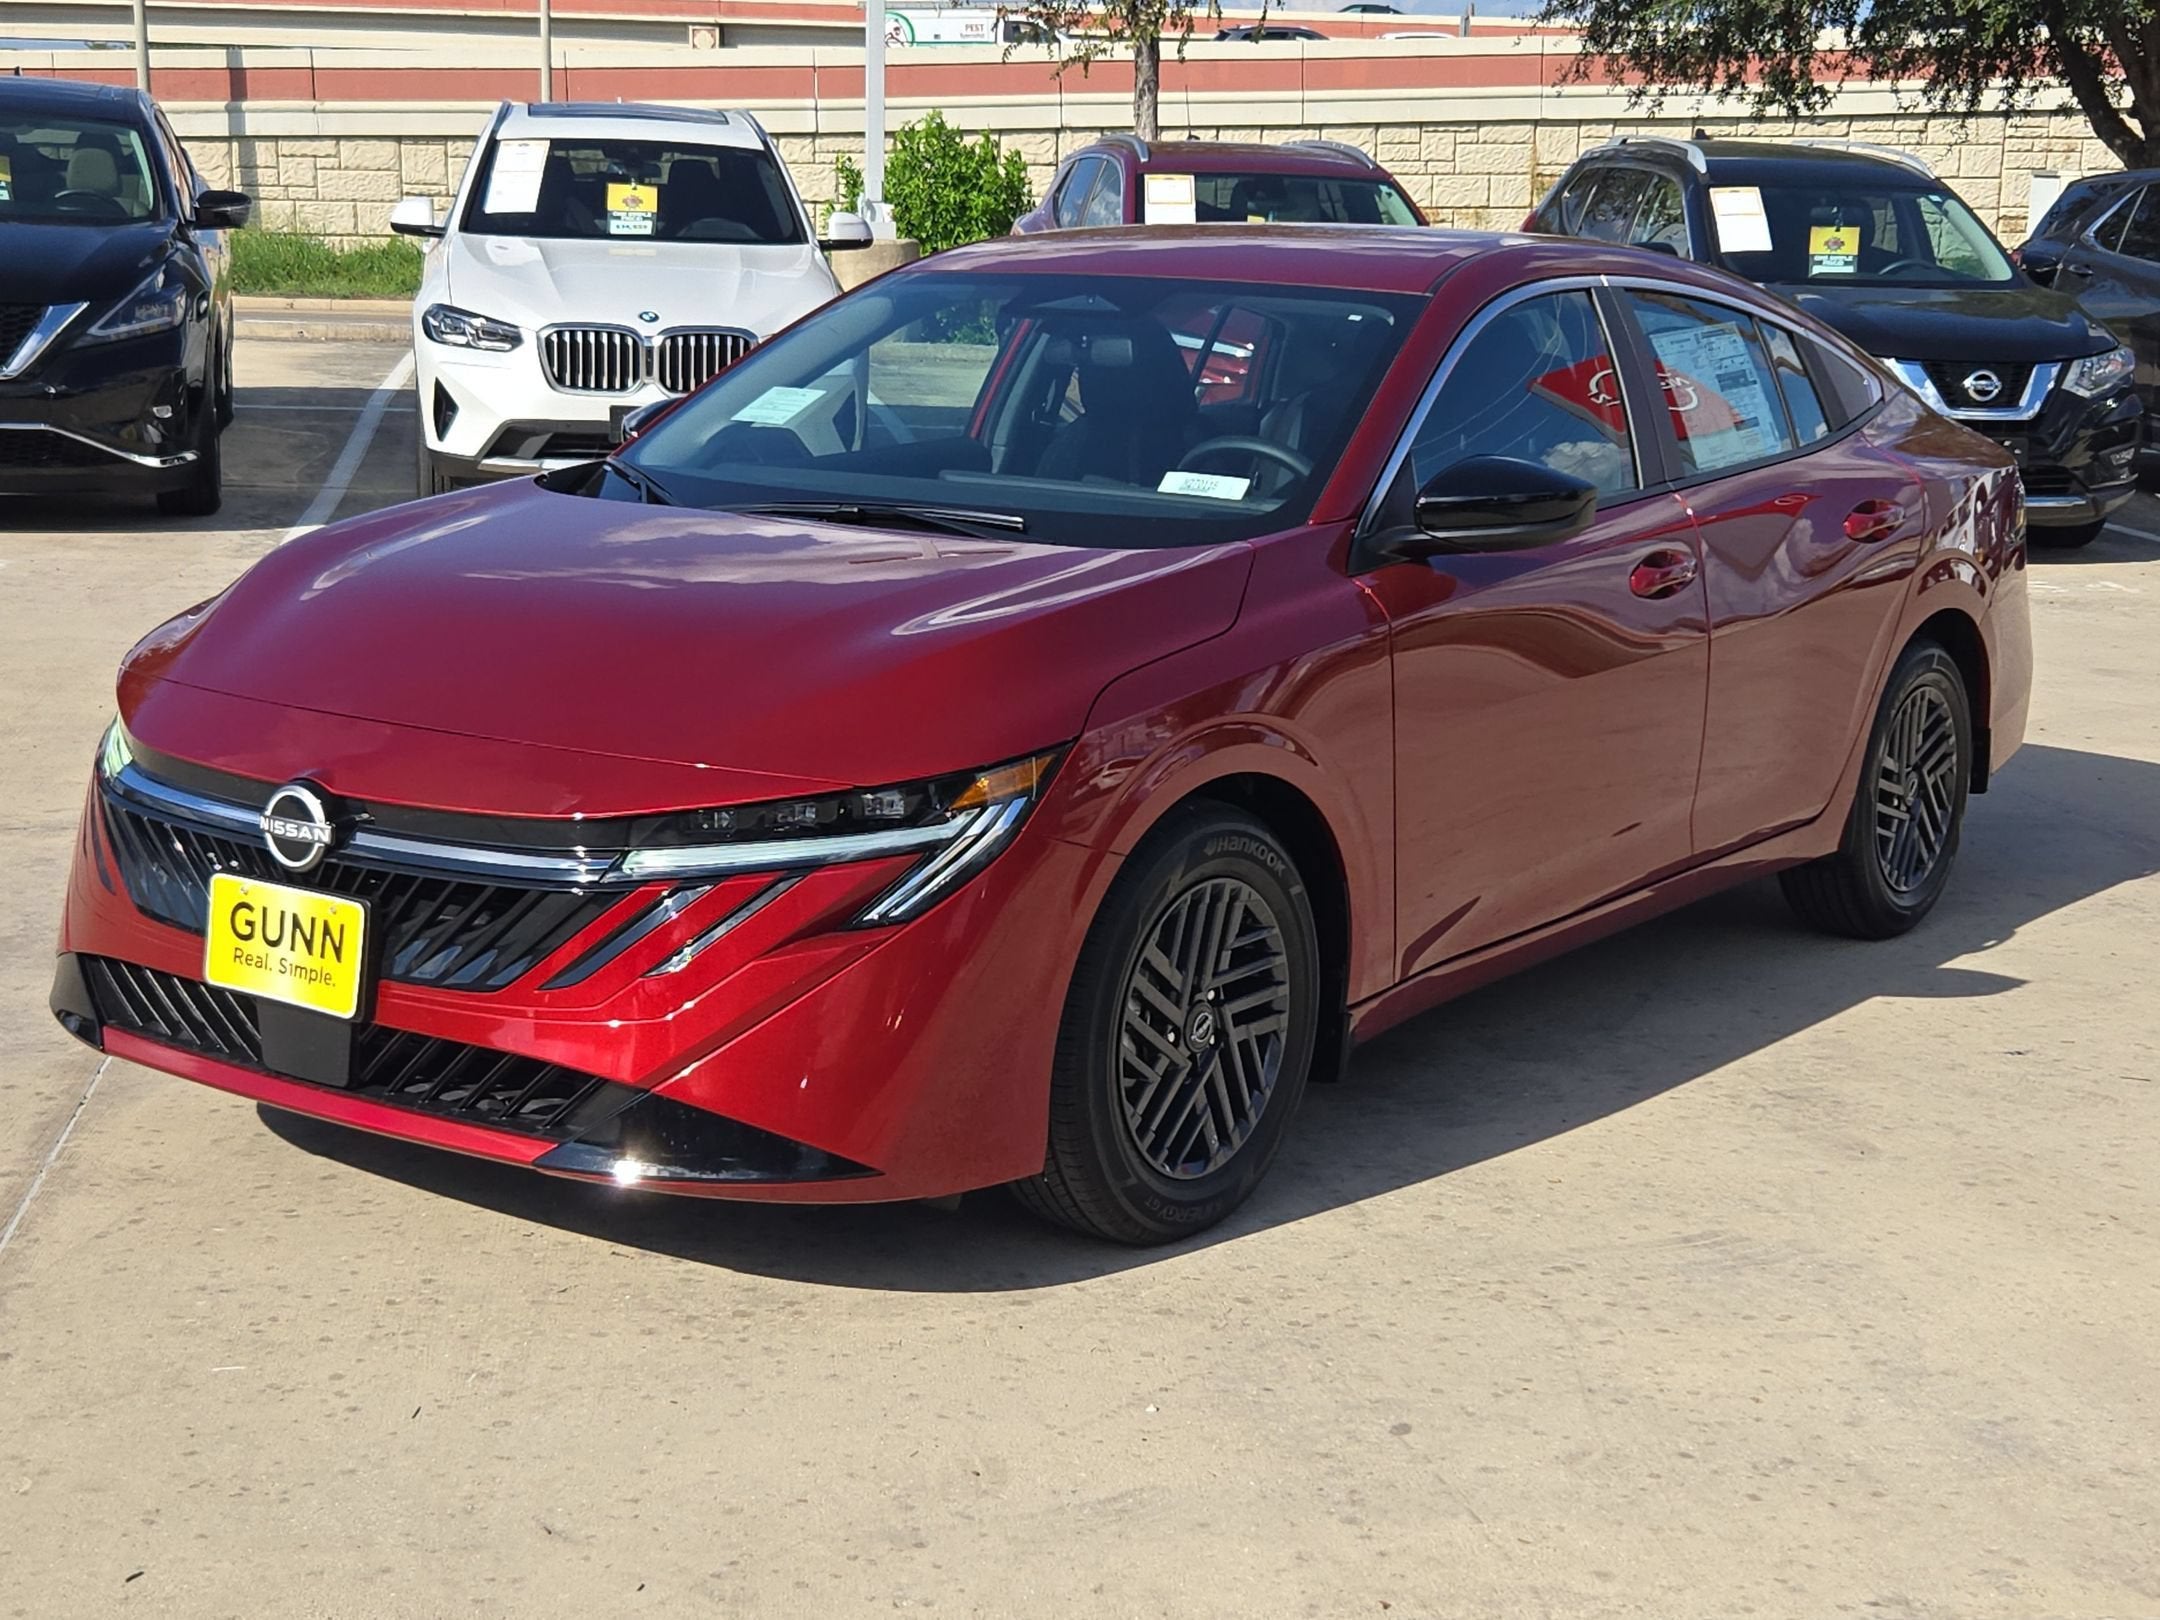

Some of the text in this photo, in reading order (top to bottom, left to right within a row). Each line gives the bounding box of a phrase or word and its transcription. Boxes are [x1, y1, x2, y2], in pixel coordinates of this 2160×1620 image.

[965, 24, 984, 32] PEST
[259, 815, 332, 844] NISSAN
[230, 901, 345, 963] GUNN
[233, 947, 337, 987] Real. Simple.
